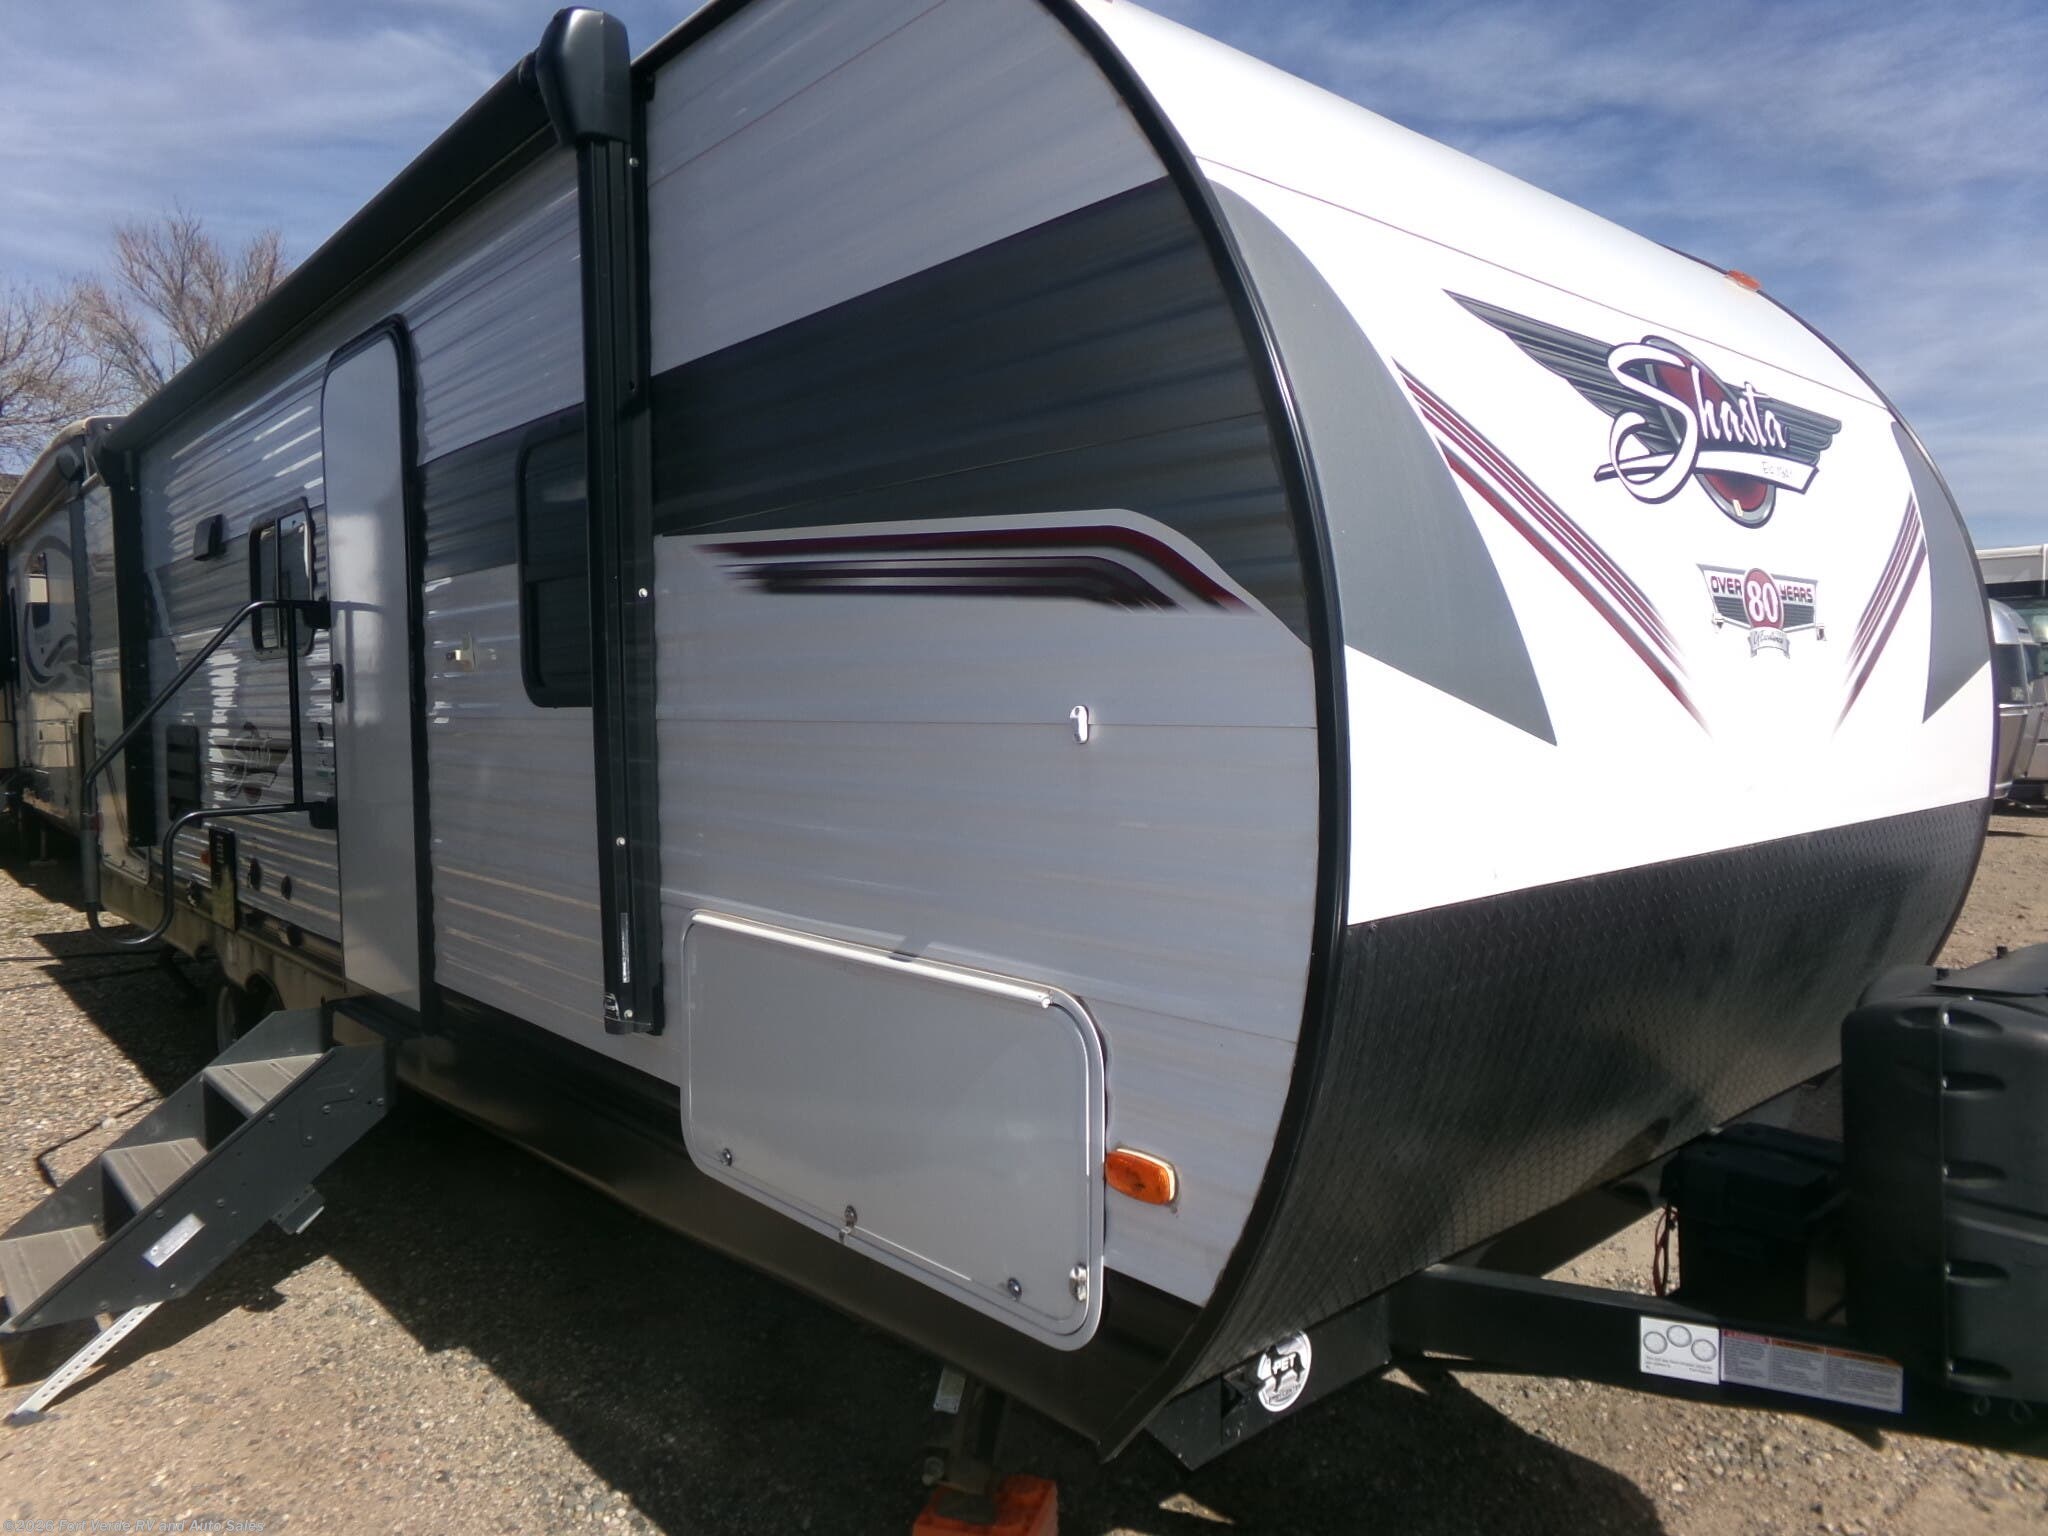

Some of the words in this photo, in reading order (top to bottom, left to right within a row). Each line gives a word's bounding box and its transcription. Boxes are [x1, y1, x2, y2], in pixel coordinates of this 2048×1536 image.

[1607, 342, 1789, 504] Shasta
[1710, 575, 1743, 595] OVER
[1746, 580, 1779, 623] 80
[1780, 583, 1814, 604] YEARS
[1272, 1352, 1297, 1375] PET
